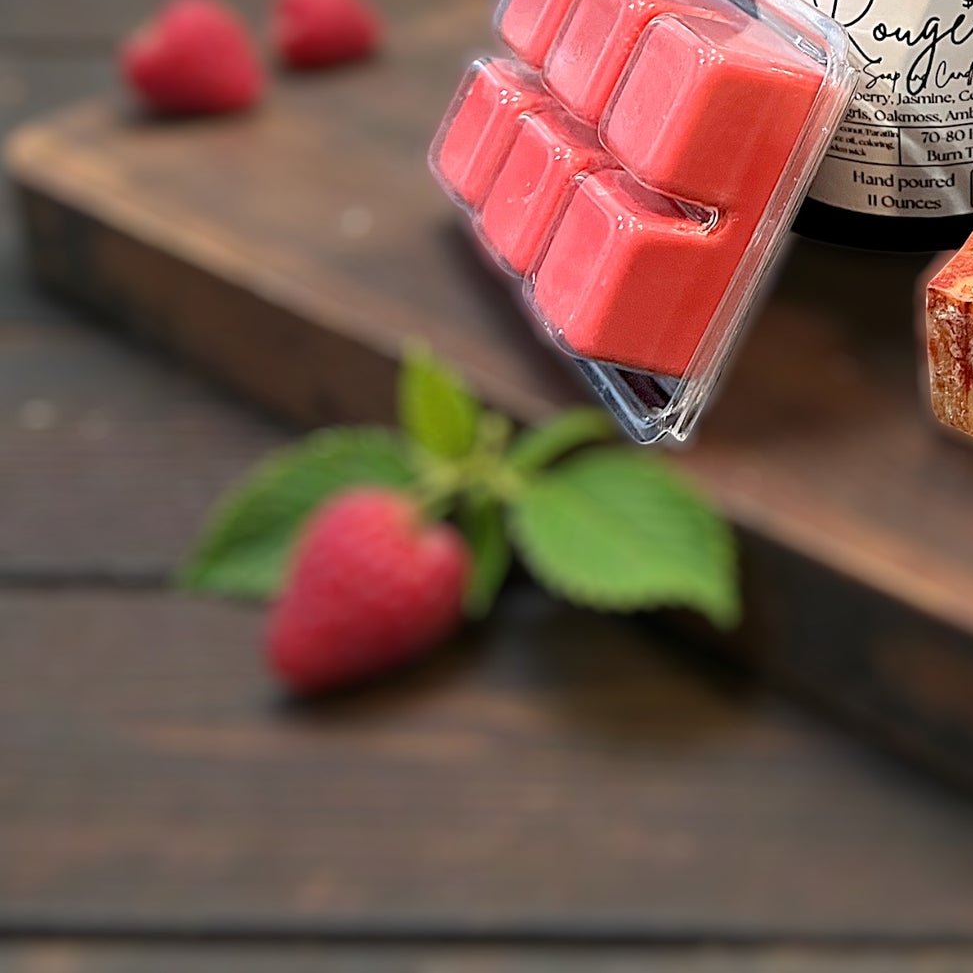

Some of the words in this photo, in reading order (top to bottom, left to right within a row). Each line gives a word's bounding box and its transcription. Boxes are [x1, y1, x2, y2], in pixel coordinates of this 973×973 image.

[897, 92, 956, 105] Jasmine,
[874, 109, 943, 123] Oakmoss,
[927, 149, 963, 162] Burn
[853, 170, 895, 187] Hand
[898, 173, 956, 192] poured
[881, 195, 942, 210] Ounces
